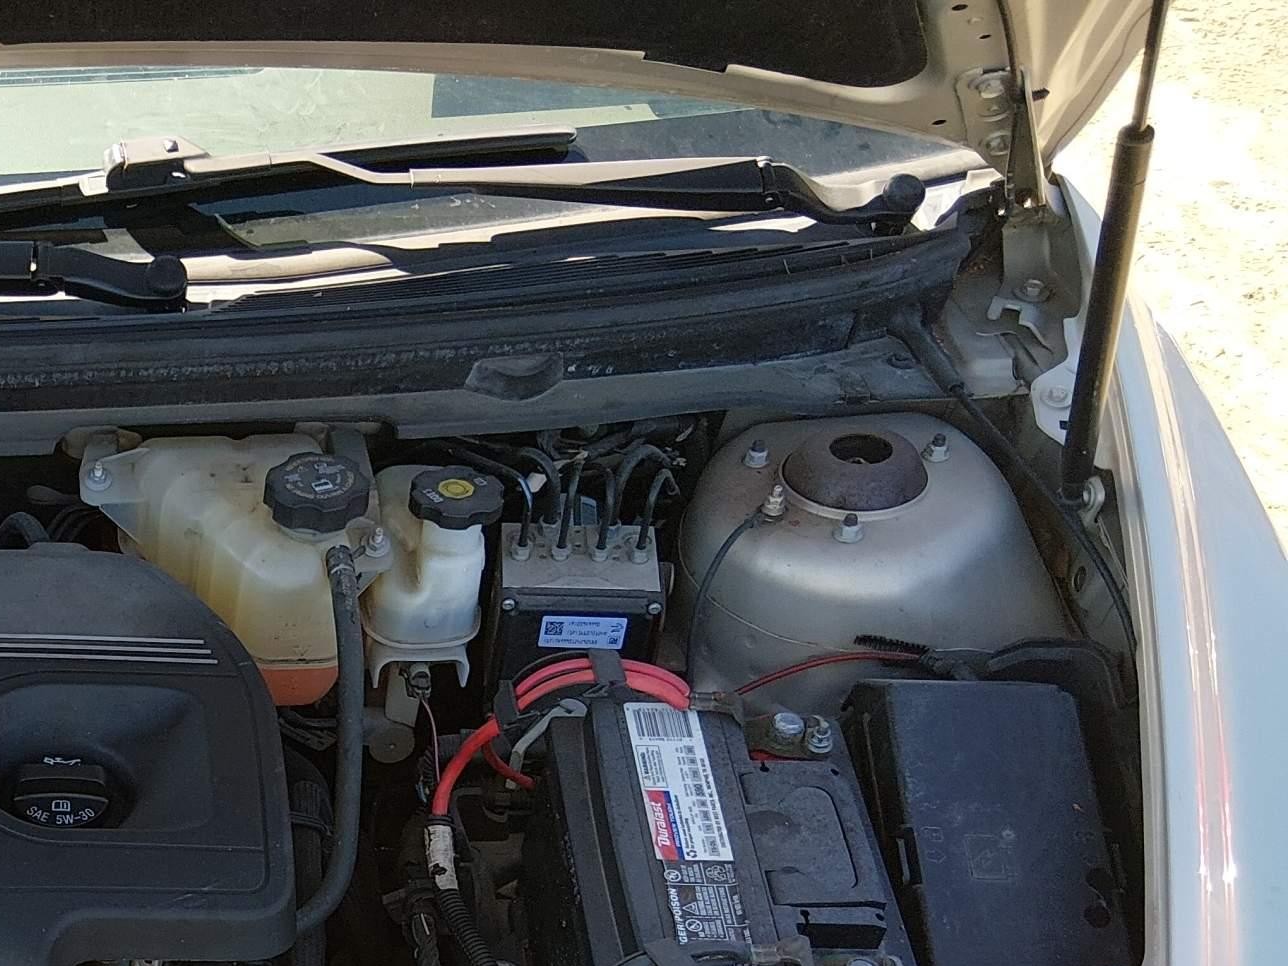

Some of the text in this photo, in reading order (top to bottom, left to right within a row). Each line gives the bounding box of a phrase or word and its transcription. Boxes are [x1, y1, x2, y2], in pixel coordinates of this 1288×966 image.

[26, 806, 95, 824] SAE 5W-30
[649, 801, 670, 847] Duralast
